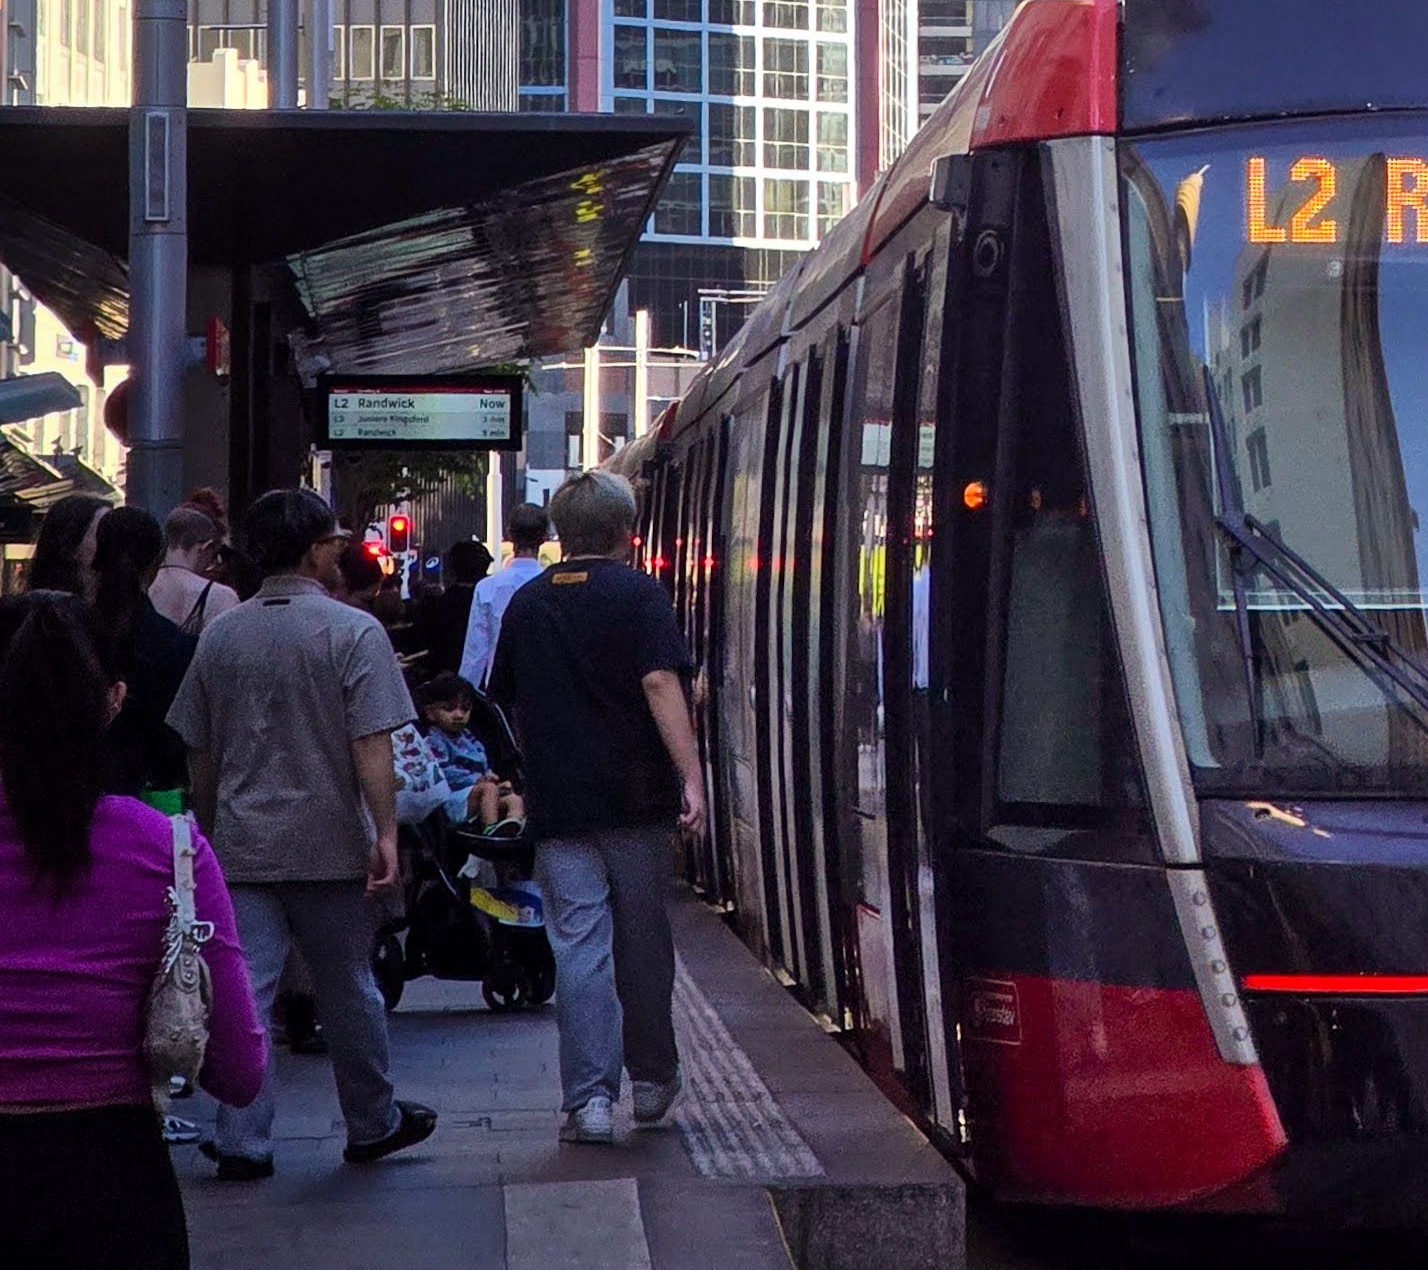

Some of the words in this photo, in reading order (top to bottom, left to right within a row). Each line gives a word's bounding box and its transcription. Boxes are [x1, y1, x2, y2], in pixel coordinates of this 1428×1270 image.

[1247, 157, 1336, 243] L2
[334, 398, 349, 409] L2
[358, 398, 415, 409] Randwick
[480, 398, 505, 409] Now
